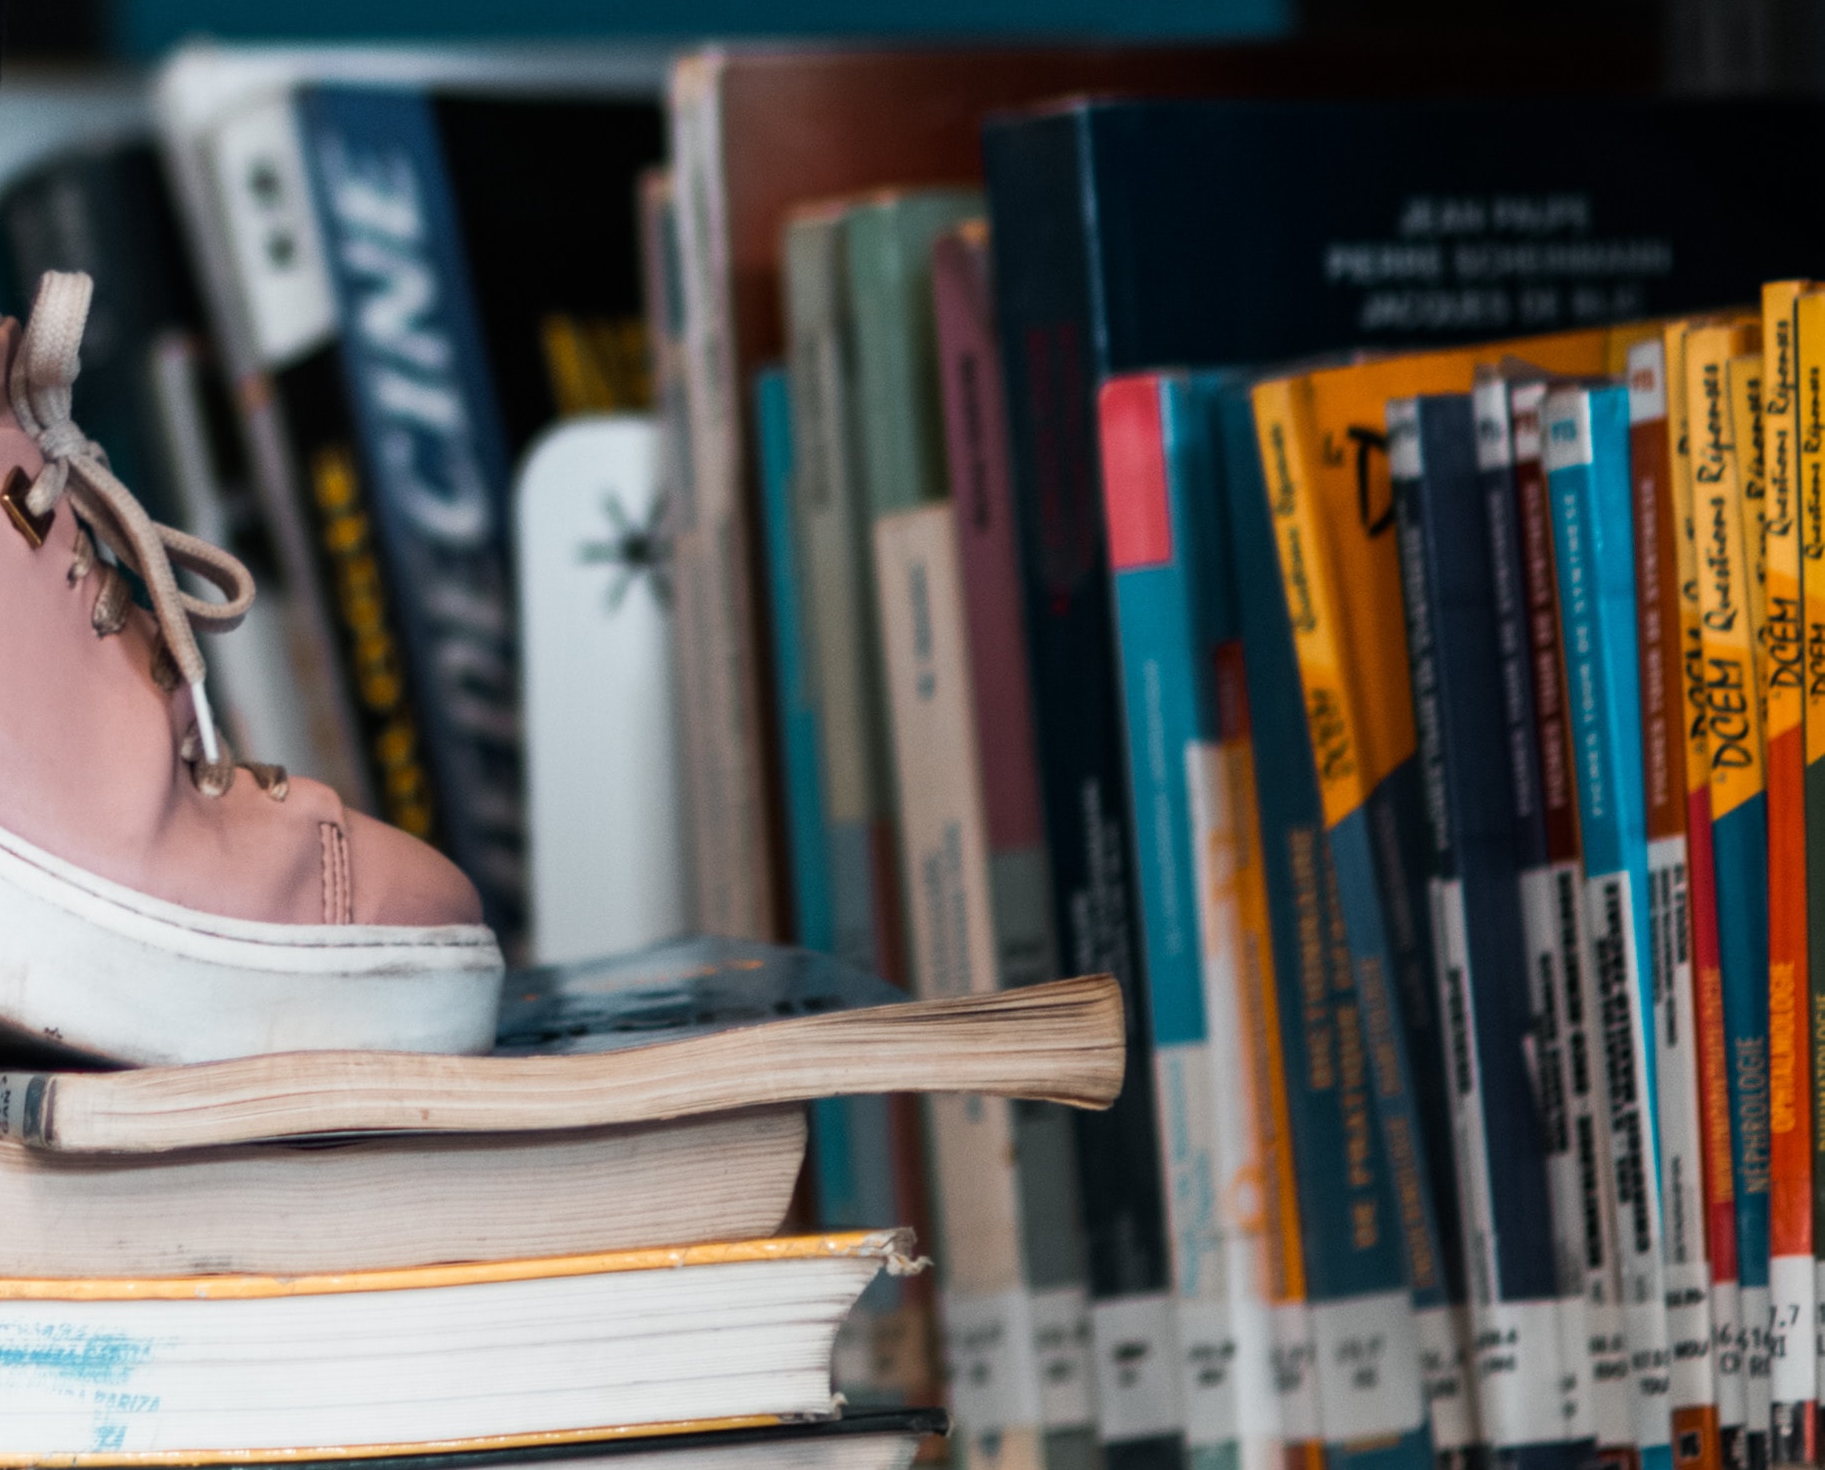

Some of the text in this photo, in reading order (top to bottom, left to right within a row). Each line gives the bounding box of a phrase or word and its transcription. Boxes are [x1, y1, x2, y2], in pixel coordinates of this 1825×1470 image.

[1764, 319, 1796, 415] Réponses
[1688, 362, 1734, 484] Réponses
[1762, 429, 1793, 537] Questions
[1804, 462, 1824, 559] Questions
[1694, 495, 1737, 633] Questions
[1577, 664, 1598, 724] TOUR
[1736, 1036, 1771, 1193] NÉPHROLOGIE
